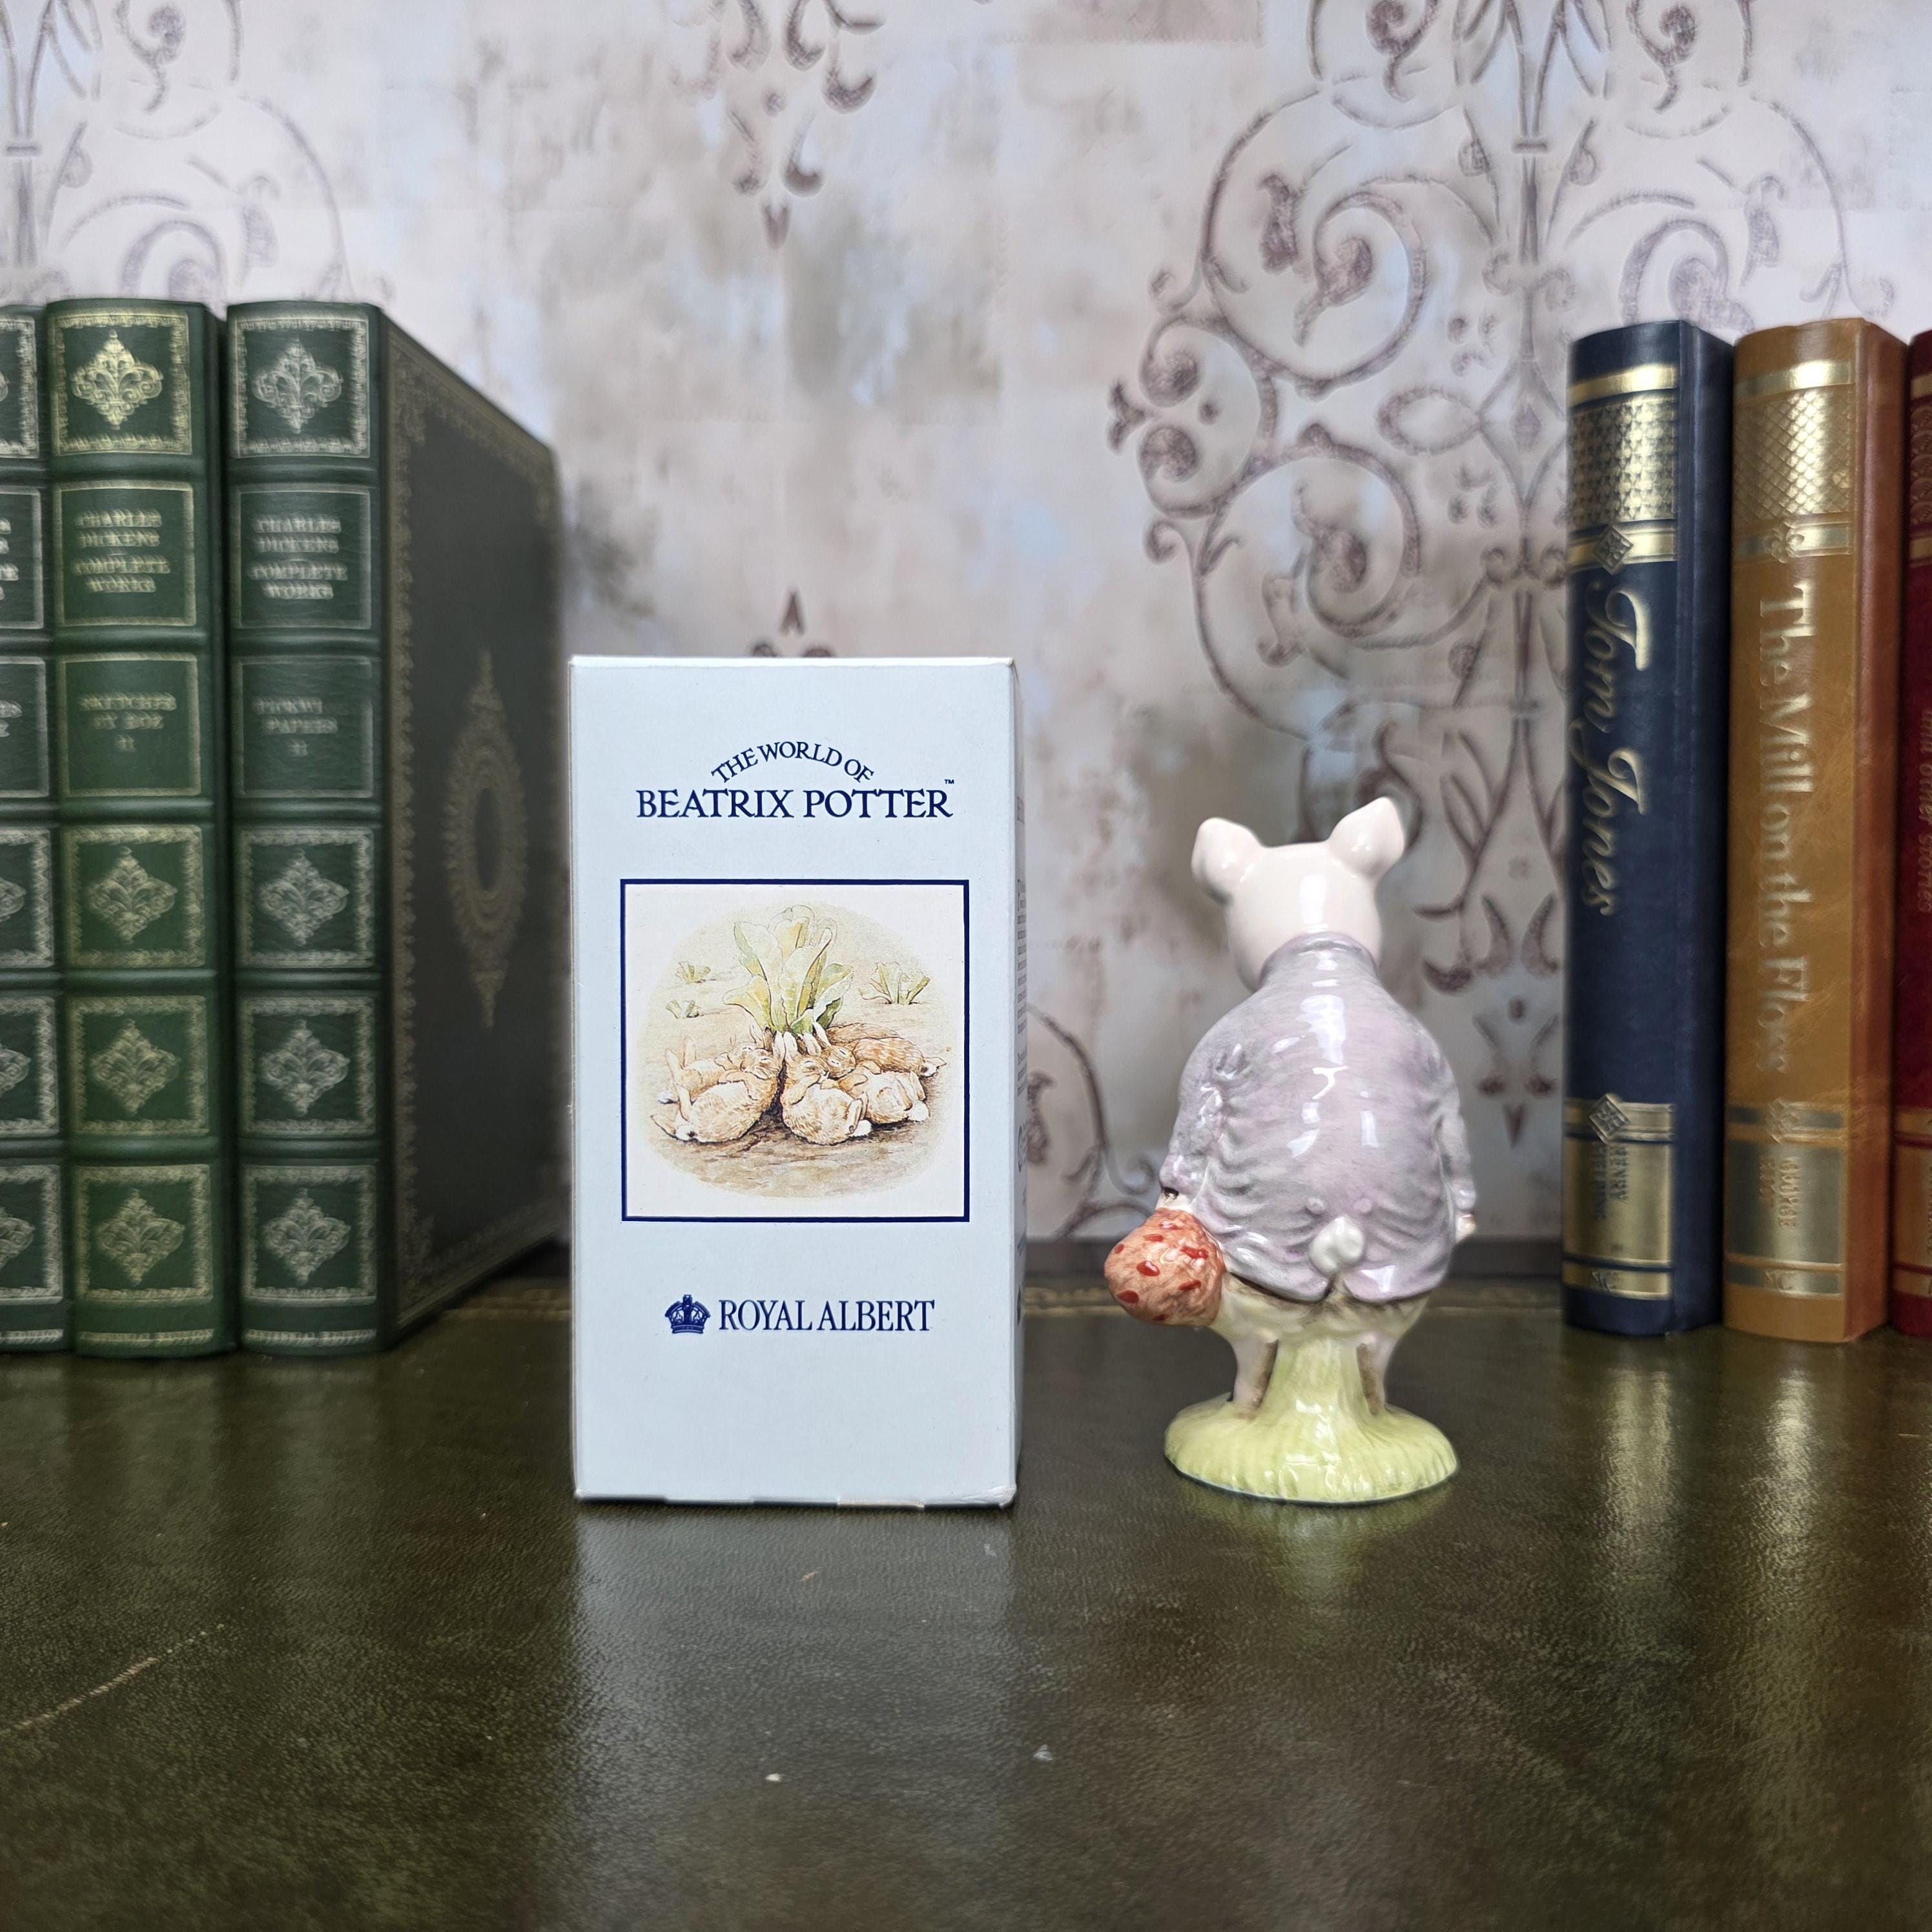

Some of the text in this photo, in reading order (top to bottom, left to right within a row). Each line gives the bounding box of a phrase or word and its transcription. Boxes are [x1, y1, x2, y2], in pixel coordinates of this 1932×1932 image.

[1759, 580, 1816, 686] The
[710, 741, 874, 783] THE WORLD OF
[1567, 579, 1652, 917] Tom Jones
[1759, 693, 1814, 794] Mill
[635, 788, 795, 818] BEATRIX
[803, 788, 954, 818] POTTER
[1759, 803, 1791, 863] on
[1758, 870, 1812, 948] the
[718, 1299, 935, 1331] ROYAL ALBERT
